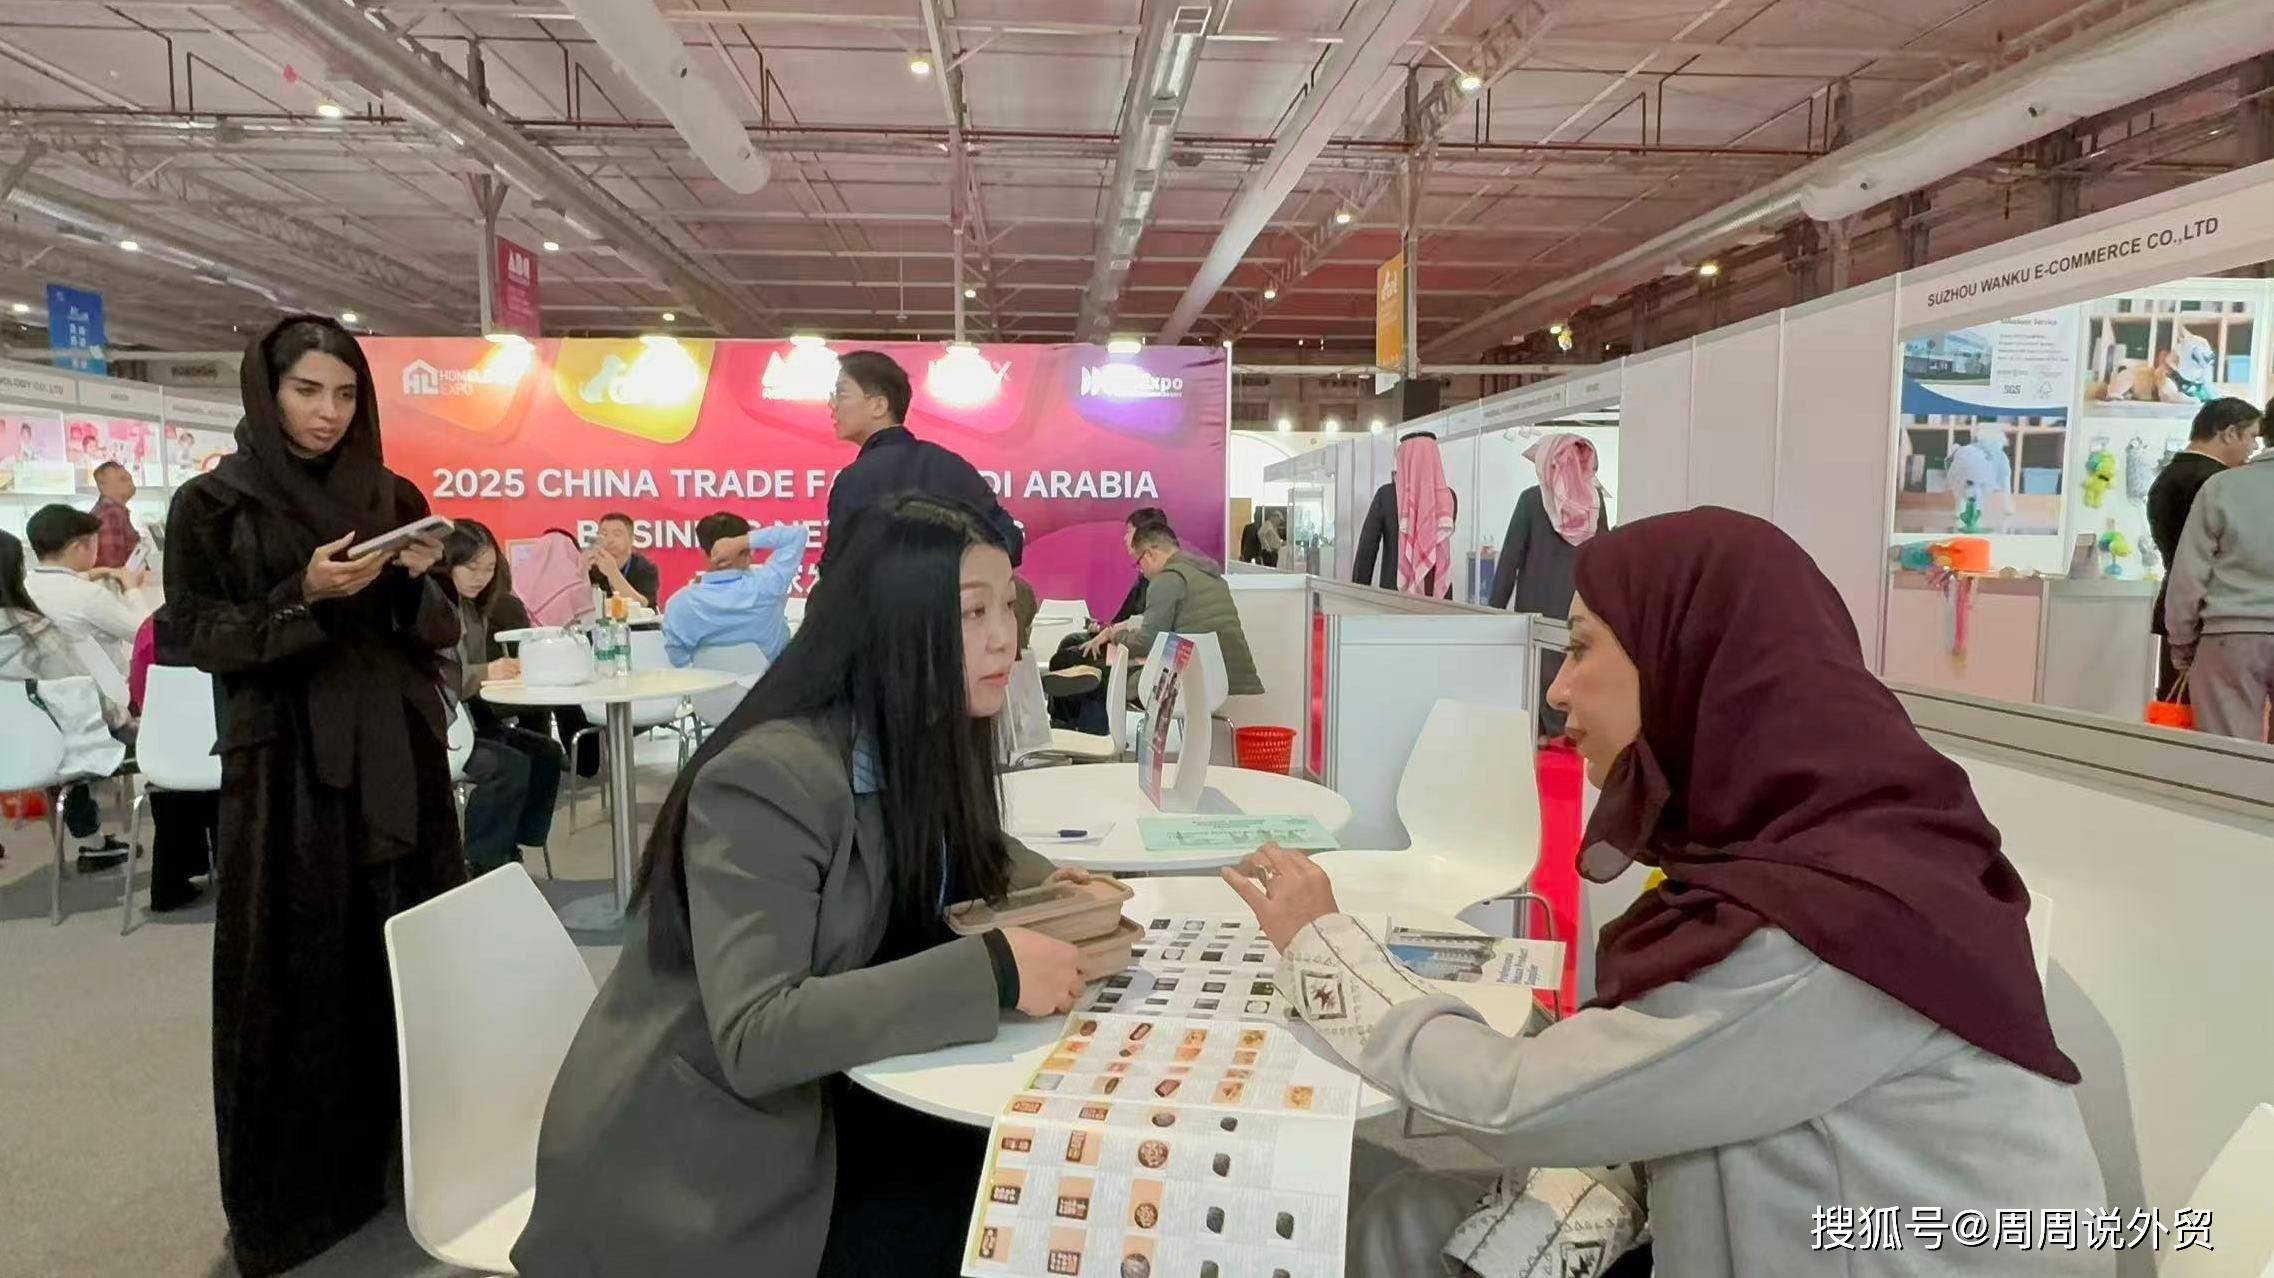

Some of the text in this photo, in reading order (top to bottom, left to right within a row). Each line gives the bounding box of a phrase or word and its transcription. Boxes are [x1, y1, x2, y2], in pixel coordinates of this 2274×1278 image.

[1928, 217, 2218, 307] SUZHOU WANKU E-COMMERCE CO.,LTD
[433, 468, 525, 498] 2025
[537, 468, 660, 498] CHINA
[670, 469, 795, 498] TRADE
[1024, 470, 1158, 499] ARABIA
